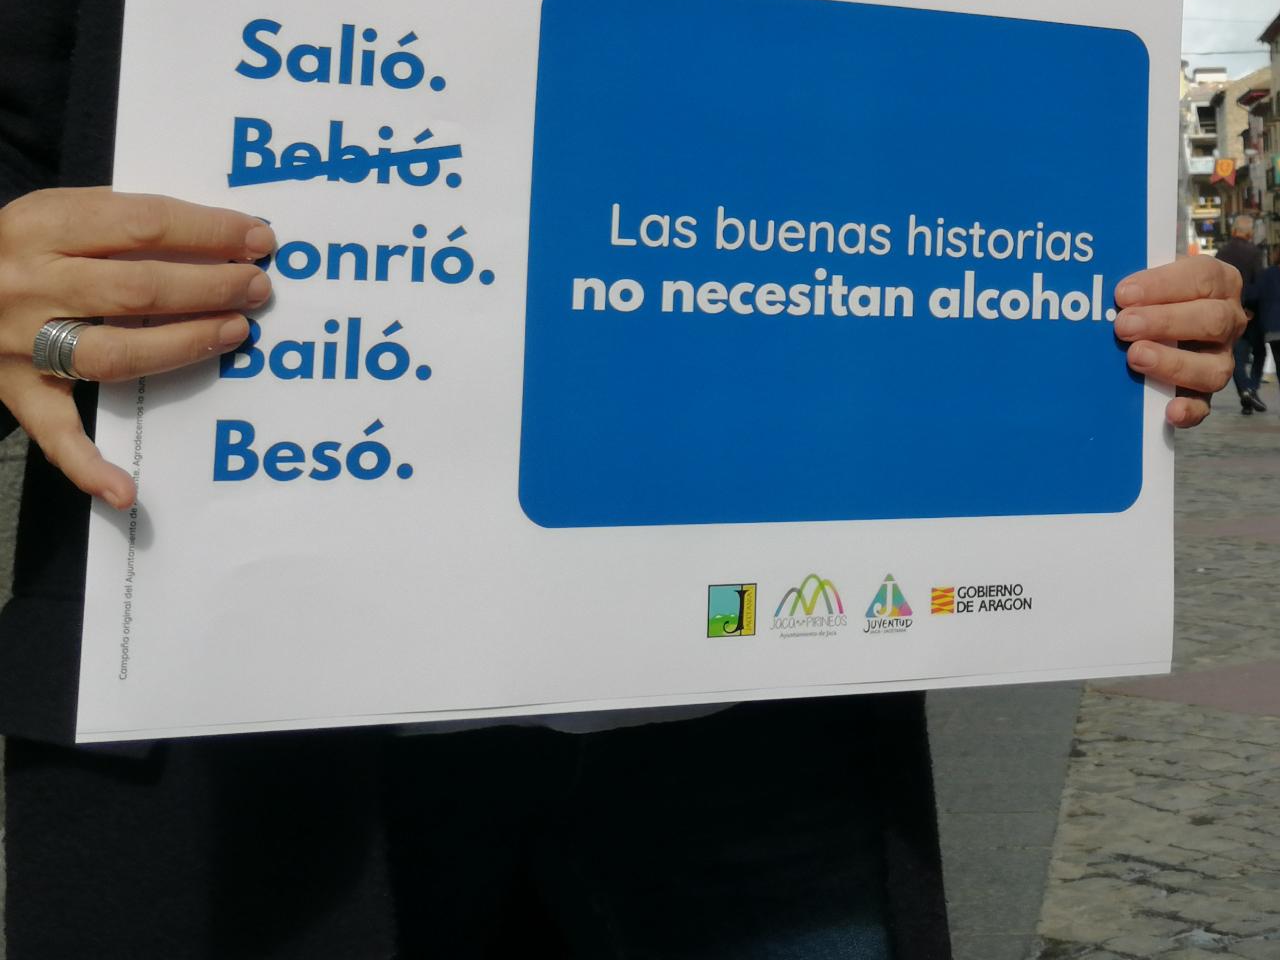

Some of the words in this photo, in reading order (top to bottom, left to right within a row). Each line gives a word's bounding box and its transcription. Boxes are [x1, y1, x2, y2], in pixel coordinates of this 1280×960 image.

[235, 18, 447, 92] Salió.
[227, 116, 463, 189] Bebió.
[229, 217, 496, 286] onrió.
[611, 203, 698, 249] Las
[715, 206, 891, 256] buenas
[907, 214, 1094, 262] historias
[572, 277, 645, 312] no
[661, 267, 914, 318] necesitan
[928, 270, 1118, 322] alcohol.
[220, 317, 433, 382] Bailó.
[132, 406, 144, 467] Agradecemos
[212, 419, 414, 482] Besó.
[129, 507, 137, 519] de
[125, 521, 137, 583] Ayuntamiento
[122, 600, 132, 635] original
[124, 585, 133, 600] del
[956, 600, 973, 614] DE
[979, 597, 1033, 612] ARAGON
[957, 583, 1024, 599] GOBIERNO
[863, 618, 913, 634] JUVENTUD
[118, 636, 130, 681] Campaña
